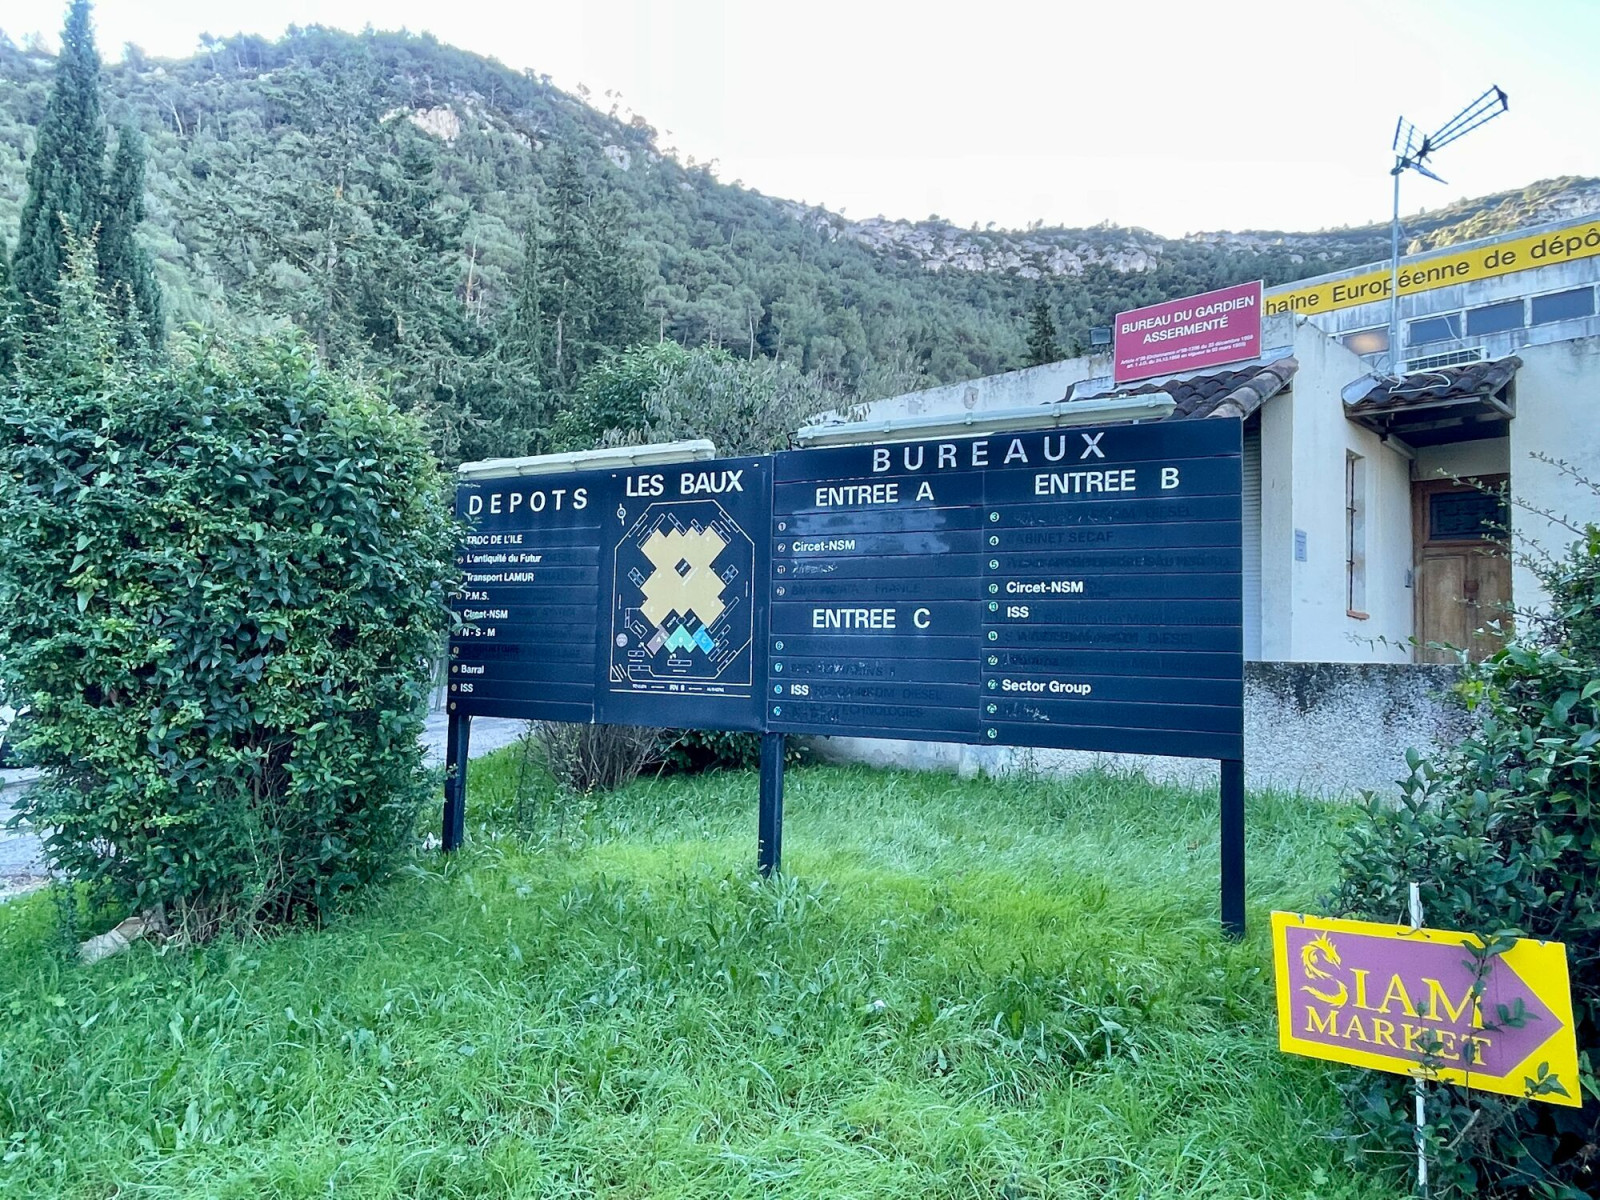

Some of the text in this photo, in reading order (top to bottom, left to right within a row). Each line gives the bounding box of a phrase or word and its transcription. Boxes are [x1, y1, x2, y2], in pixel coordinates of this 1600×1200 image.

[1263, 293, 1319, 315] haîne
[1332, 261, 1470, 304] Européenne
[1483, 249, 1516, 269] de
[1121, 295, 1255, 334] BUREAU DU GARDIEN
[1143, 314, 1229, 344] ASSERMENTÉ
[872, 432, 1106, 473] BUREAUX
[626, 469, 744, 497] LES BAUX
[1034, 466, 1181, 496] ENTREE B
[468, 487, 588, 516] DEPOTS
[815, 480, 935, 507] ENTREE A
[467, 535, 489, 545] TROC
[490, 535, 503, 545] DE
[792, 539, 856, 552] Circet-NSM
[466, 553, 507, 564] L'antiquité
[508, 554, 518, 563] du
[520, 554, 542, 563] Futur
[466, 572, 534, 583] Transport LAMUR
[1006, 581, 1084, 594] Circet-NSM
[464, 592, 490, 601] P.M.S.
[463, 609, 509, 619] Cit-NSM
[812, 607, 931, 629] ENTREE C
[1006, 606, 1030, 618] ISS
[461, 664, 485, 674] Barral
[460, 683, 474, 693] ISS
[790, 684, 809, 696] ISS
[1001, 679, 1046, 692] Sector
[1049, 680, 1092, 696] Group
[1300, 930, 1488, 1031] SIAM
[1304, 1005, 1492, 1067] MARKET
